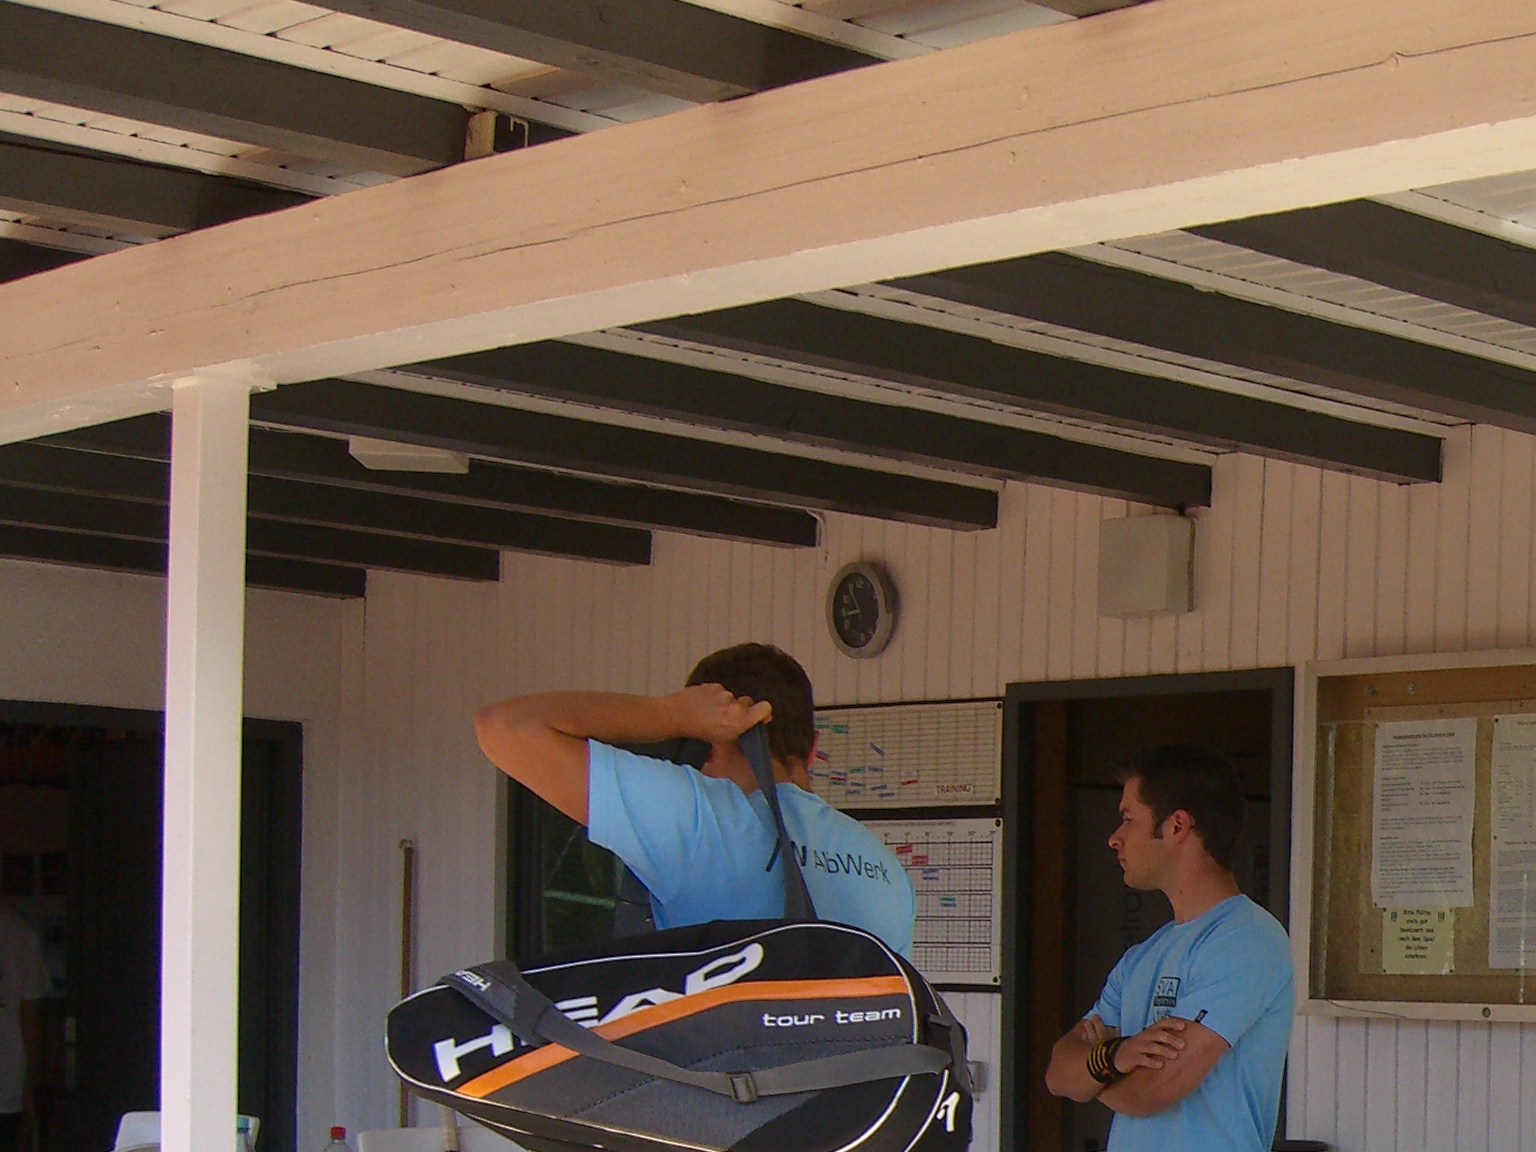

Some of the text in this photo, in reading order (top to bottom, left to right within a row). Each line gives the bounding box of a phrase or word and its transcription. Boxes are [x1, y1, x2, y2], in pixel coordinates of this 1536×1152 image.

[936, 784, 971, 794] TRAINING
[432, 941, 764, 1083] HEAD
[762, 1007, 902, 1028] tour team
